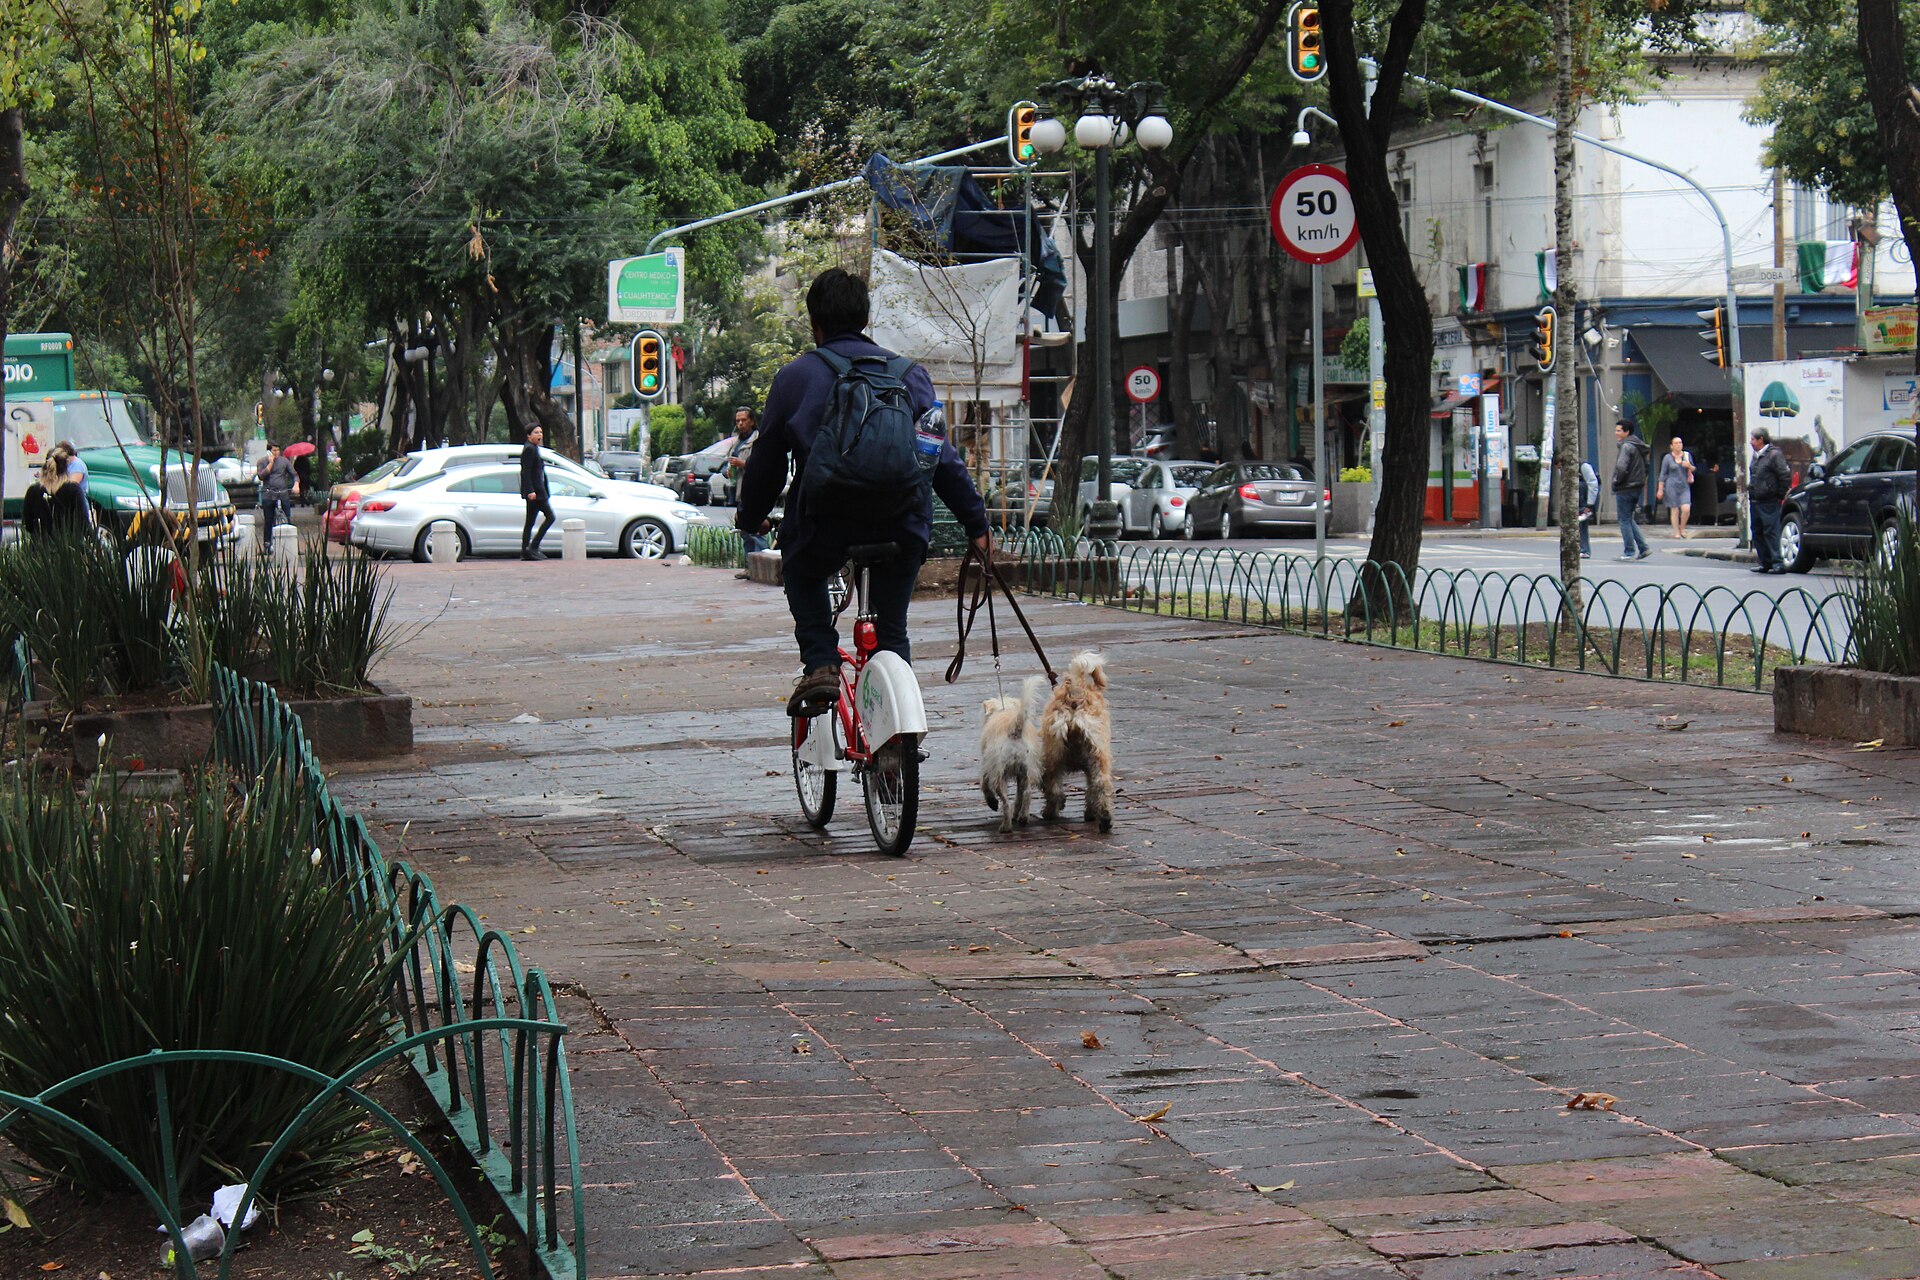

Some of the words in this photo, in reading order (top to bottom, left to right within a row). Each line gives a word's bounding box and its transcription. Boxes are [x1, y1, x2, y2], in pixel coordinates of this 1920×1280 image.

[1297, 190, 1337, 216] 50
[1298, 223, 1339, 241] km/h
[624, 271, 648, 279] CENTRO
[623, 291, 671, 300] CUAUHTEMOC
[4, 363, 34, 382] DIO
[1135, 375, 1151, 385] 50
